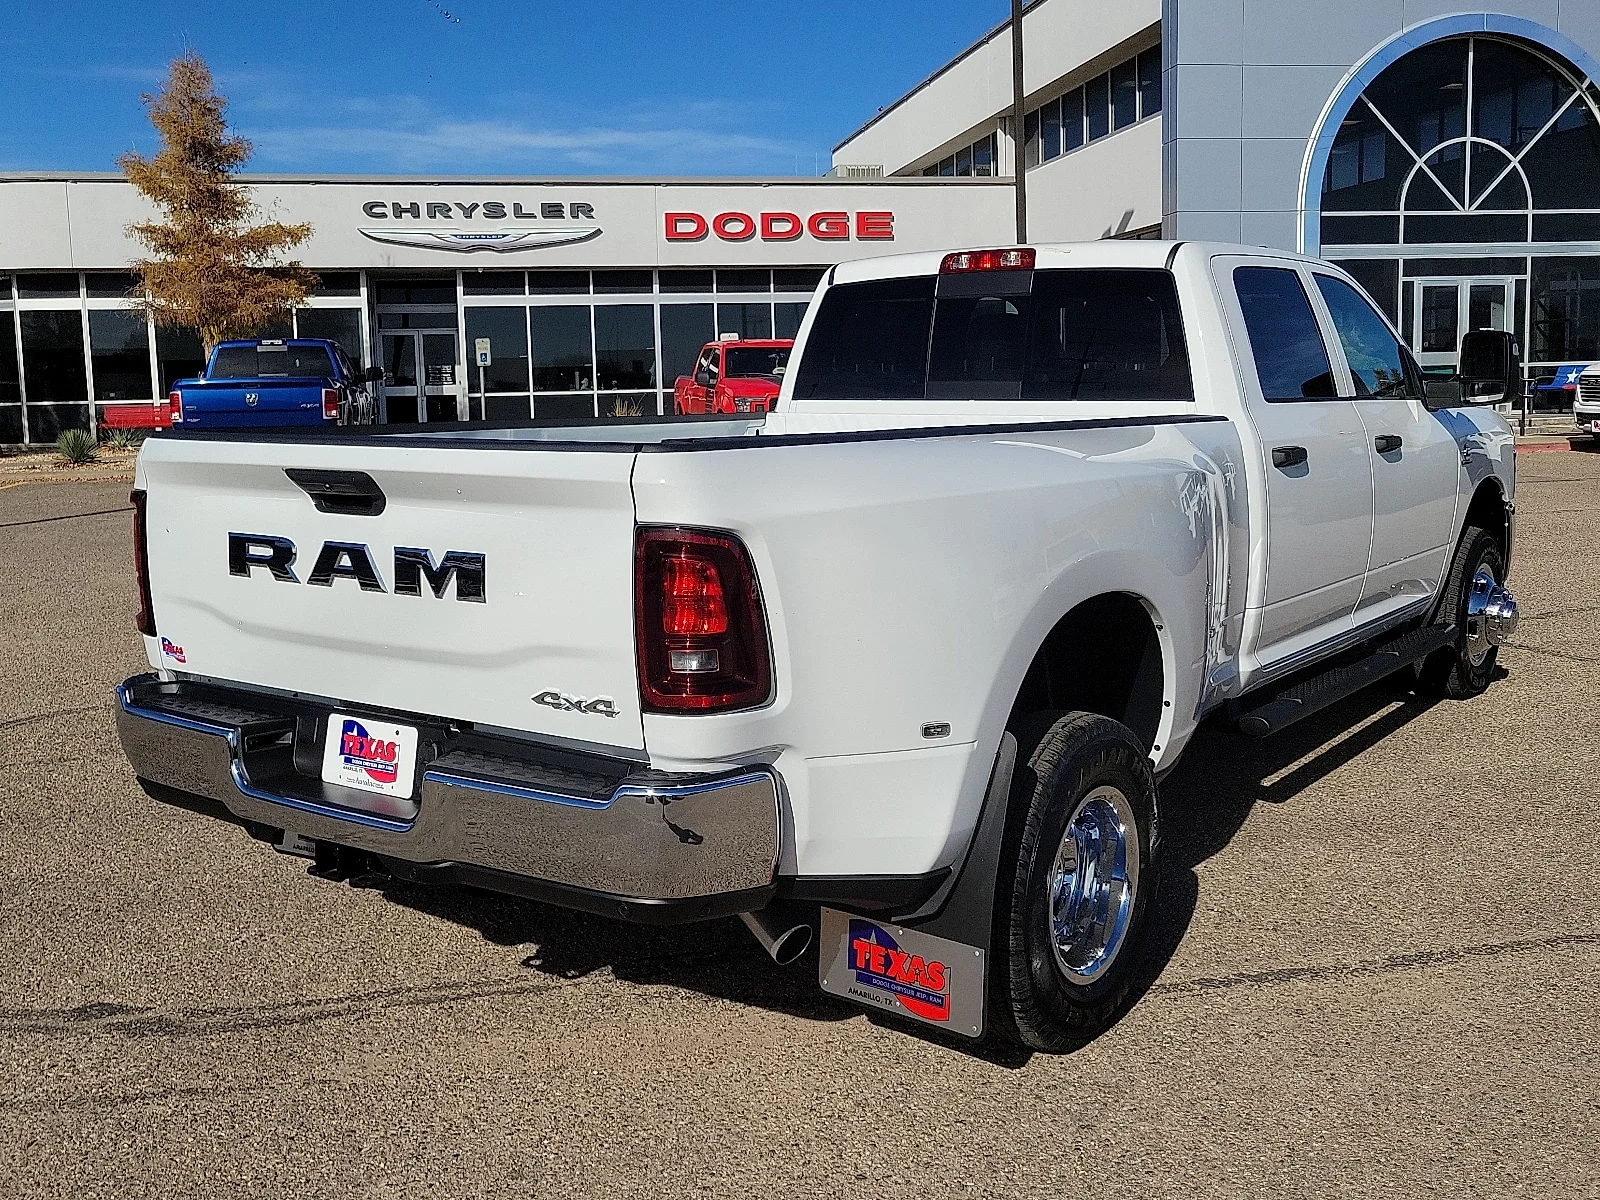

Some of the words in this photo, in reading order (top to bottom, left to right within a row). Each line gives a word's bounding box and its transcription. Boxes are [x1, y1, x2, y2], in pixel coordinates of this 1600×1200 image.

[362, 201, 596, 220] CHRYSLER
[665, 211, 895, 242] DODGE
[227, 531, 487, 604] RAM
[343, 733, 397, 762] TEXAS
[853, 939, 945, 991] TEXAS
[872, 977, 891, 989] DODGE
[929, 995, 943, 1005] RAM
[884, 997, 894, 1007] TX
